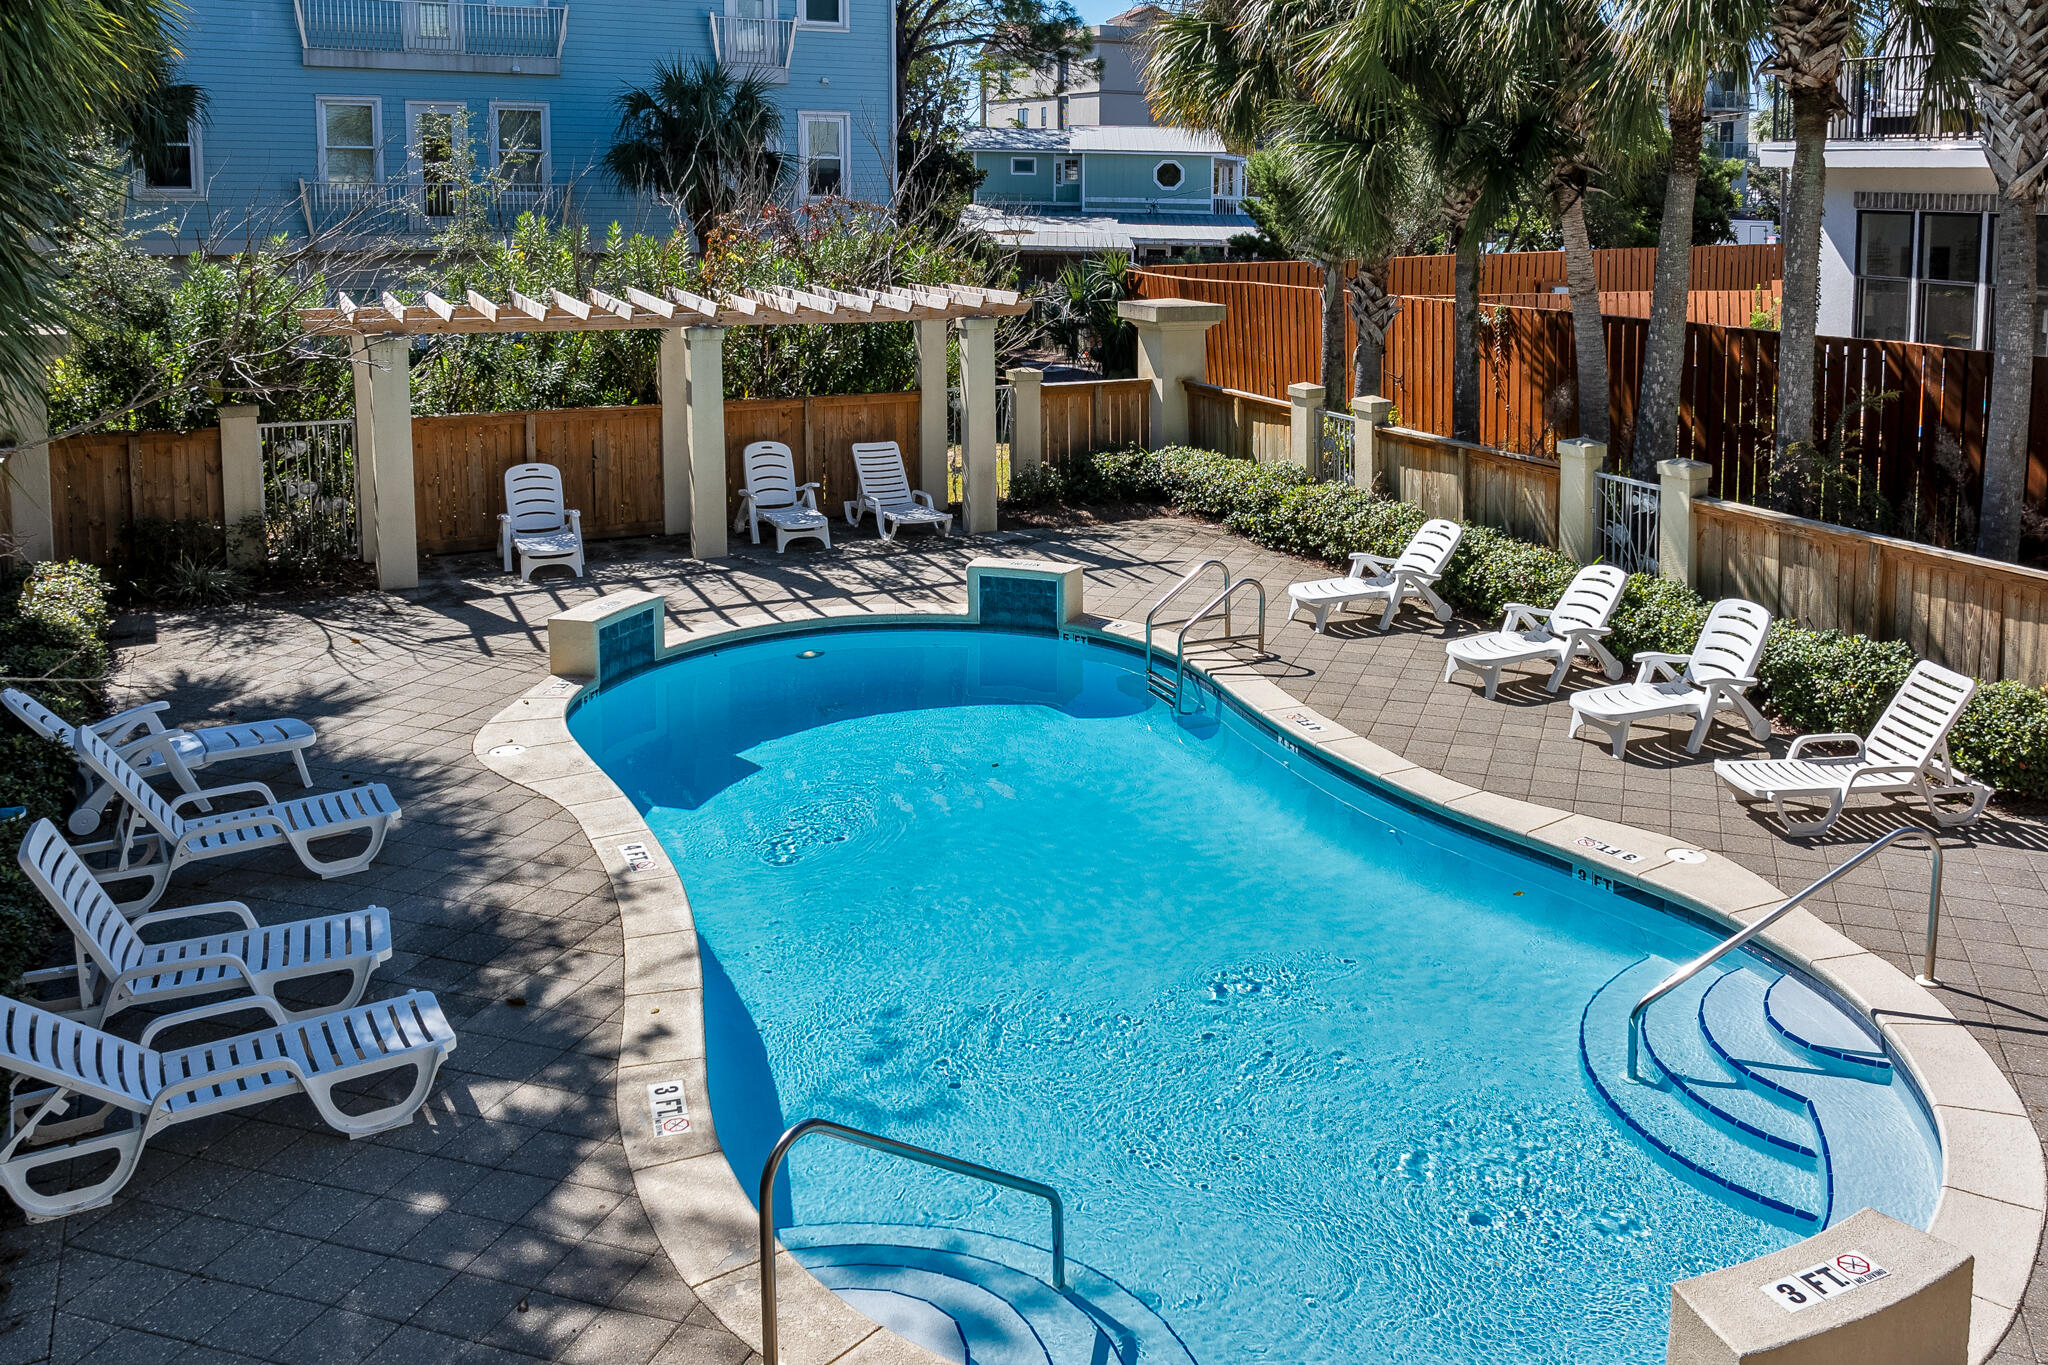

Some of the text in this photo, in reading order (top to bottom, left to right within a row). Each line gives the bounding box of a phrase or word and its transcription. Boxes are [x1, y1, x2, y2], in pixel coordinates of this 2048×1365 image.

[1074, 635, 1087, 644] FT
[1594, 874, 1612, 891] FT
[654, 1085, 683, 1117] 3 FT.
[1776, 1266, 1851, 1304] 3 FT.
[1854, 1268, 1887, 1285] NO DIVING
